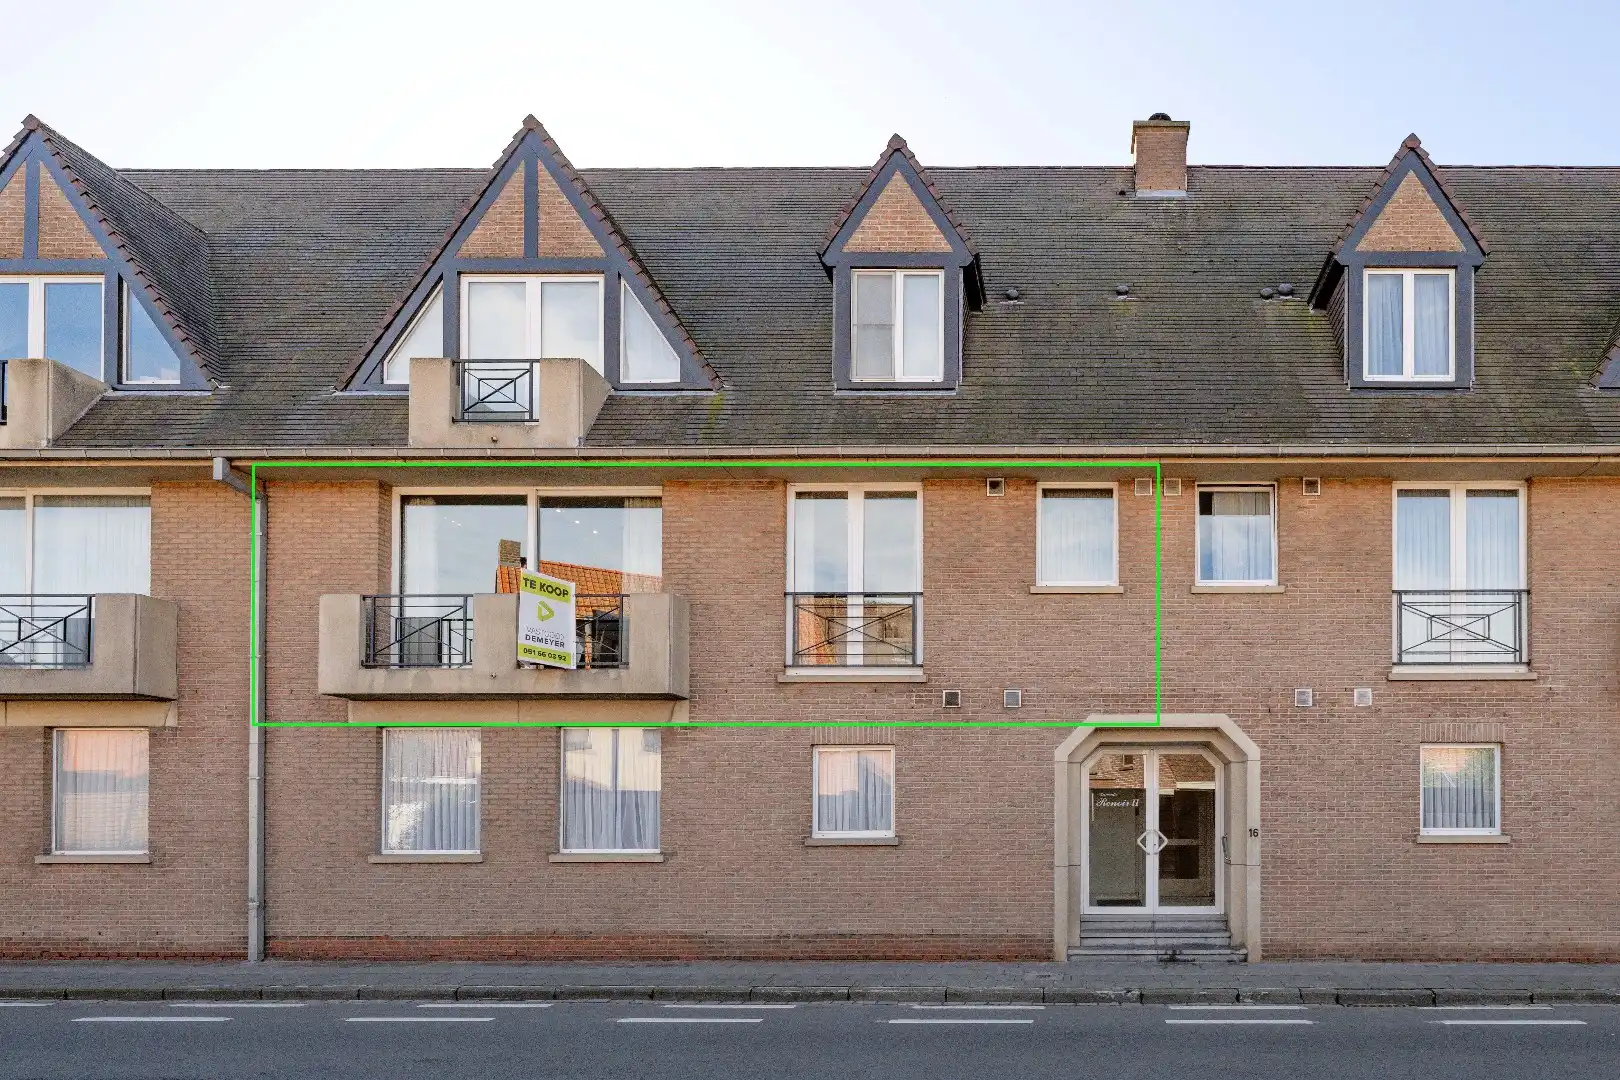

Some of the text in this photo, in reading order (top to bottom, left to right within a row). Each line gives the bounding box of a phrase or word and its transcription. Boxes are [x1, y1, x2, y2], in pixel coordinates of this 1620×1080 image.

[522, 577, 569, 598] TE KOOP
[525, 633, 565, 649] DEMEYER
[557, 654, 567, 662] 92
[1248, 828, 1259, 838] 16
